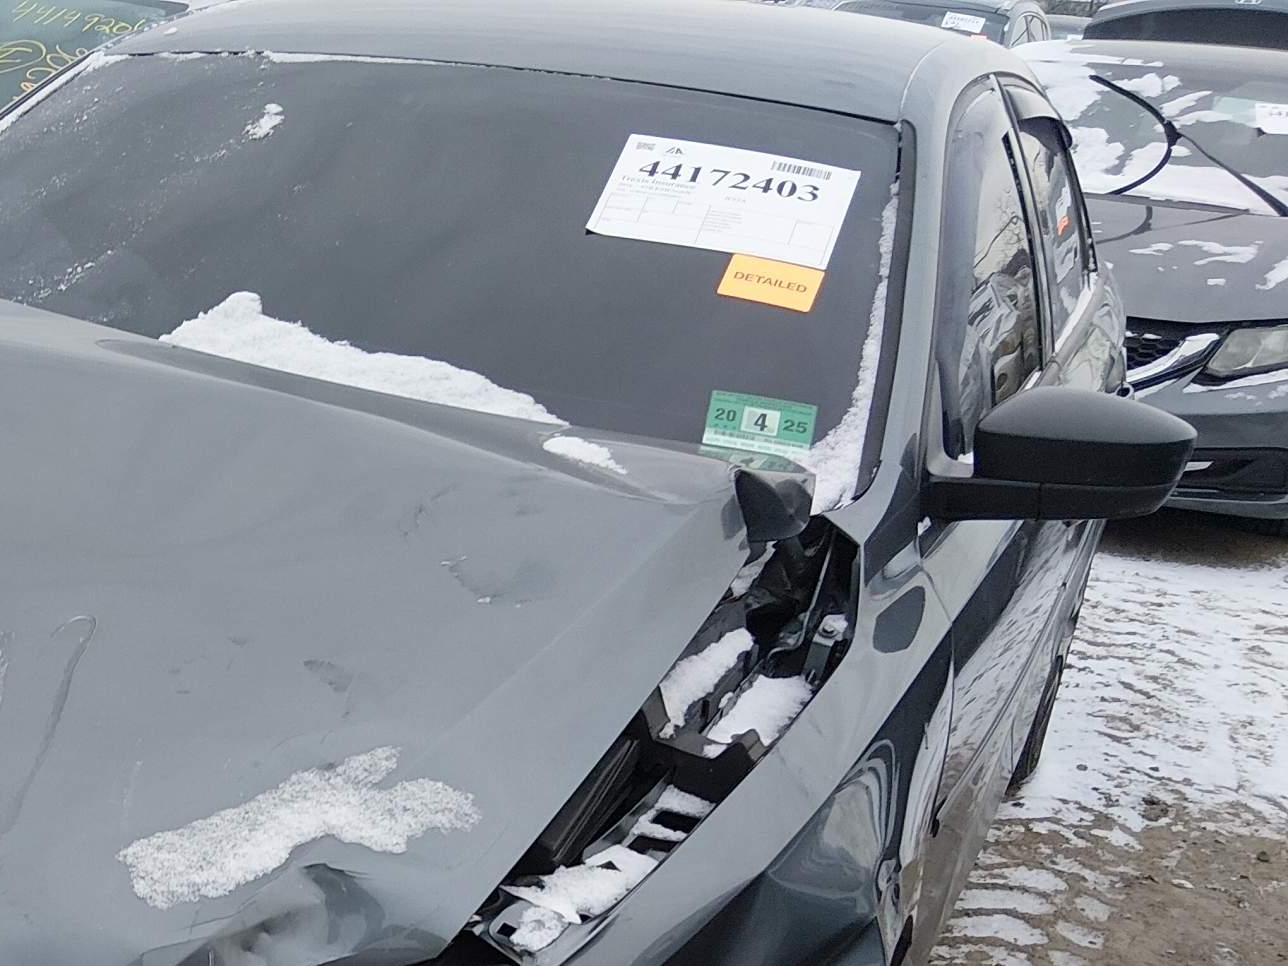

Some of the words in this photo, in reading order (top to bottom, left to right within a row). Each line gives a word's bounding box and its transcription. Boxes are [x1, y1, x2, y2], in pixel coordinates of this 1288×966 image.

[638, 160, 820, 202] 44172403
[733, 271, 808, 294] DETAILED
[714, 407, 737, 422] 20
[753, 412, 769, 432] 4
[782, 419, 809, 434] 25
